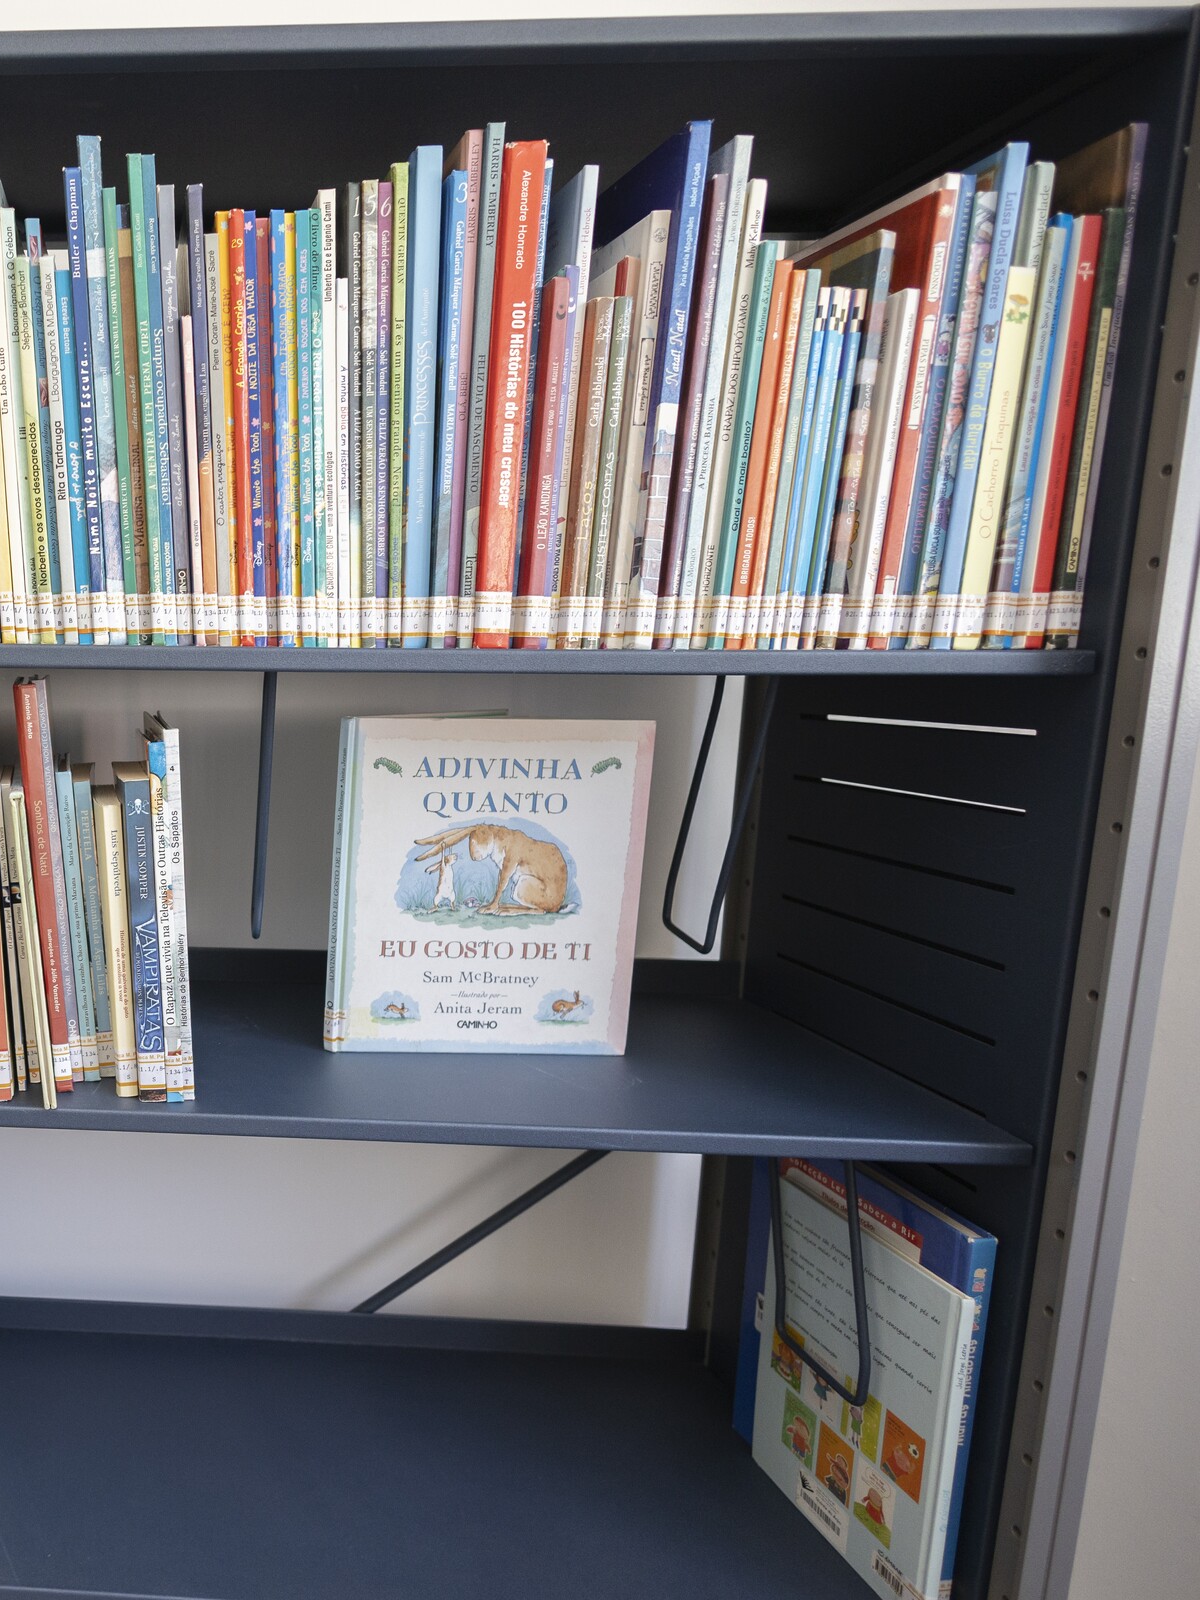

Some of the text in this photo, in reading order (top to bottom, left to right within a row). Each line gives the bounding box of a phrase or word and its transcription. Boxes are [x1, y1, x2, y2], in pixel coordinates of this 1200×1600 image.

[68, 179, 80, 278] Butler Chapman
[515, 170, 531, 269] Alexandre Honrado
[246, 278, 255, 309] MAIOR
[247, 314, 256, 338] URSA
[248, 343, 256, 356] DA
[665, 309, 686, 386] Natal! Natal!
[0, 375, 8, 396] Lobo
[248, 361, 257, 390] NOITE
[412, 340, 434, 426] PRINCESSES
[498, 301, 527, 508] 100 Histórias do meu crescer
[589, 356, 606, 427] Carla Jablonski
[2, 400, 9, 414] Um
[53, 421, 66, 470] Tartaruga
[80, 341, 101, 554] Numa Noite muito Escura...
[979, 390, 1011, 539] O Cachorro Traquinas
[55, 481, 66, 500] Rita
[413, 756, 582, 780] ADIVINHA
[423, 792, 568, 819] QUANTO
[134, 825, 148, 899] JUSTIN SOMPER
[378, 939, 592, 962] EU GOSTO DE TI
[135, 915, 162, 1051] VAMPIRATAS
[422, 971, 539, 988] Sam McBratney
[434, 1002, 522, 1016] Anita Jeram
[458, 990, 501, 1000] Ilustrado por
[456, 1019, 497, 1030] CAMINHO
